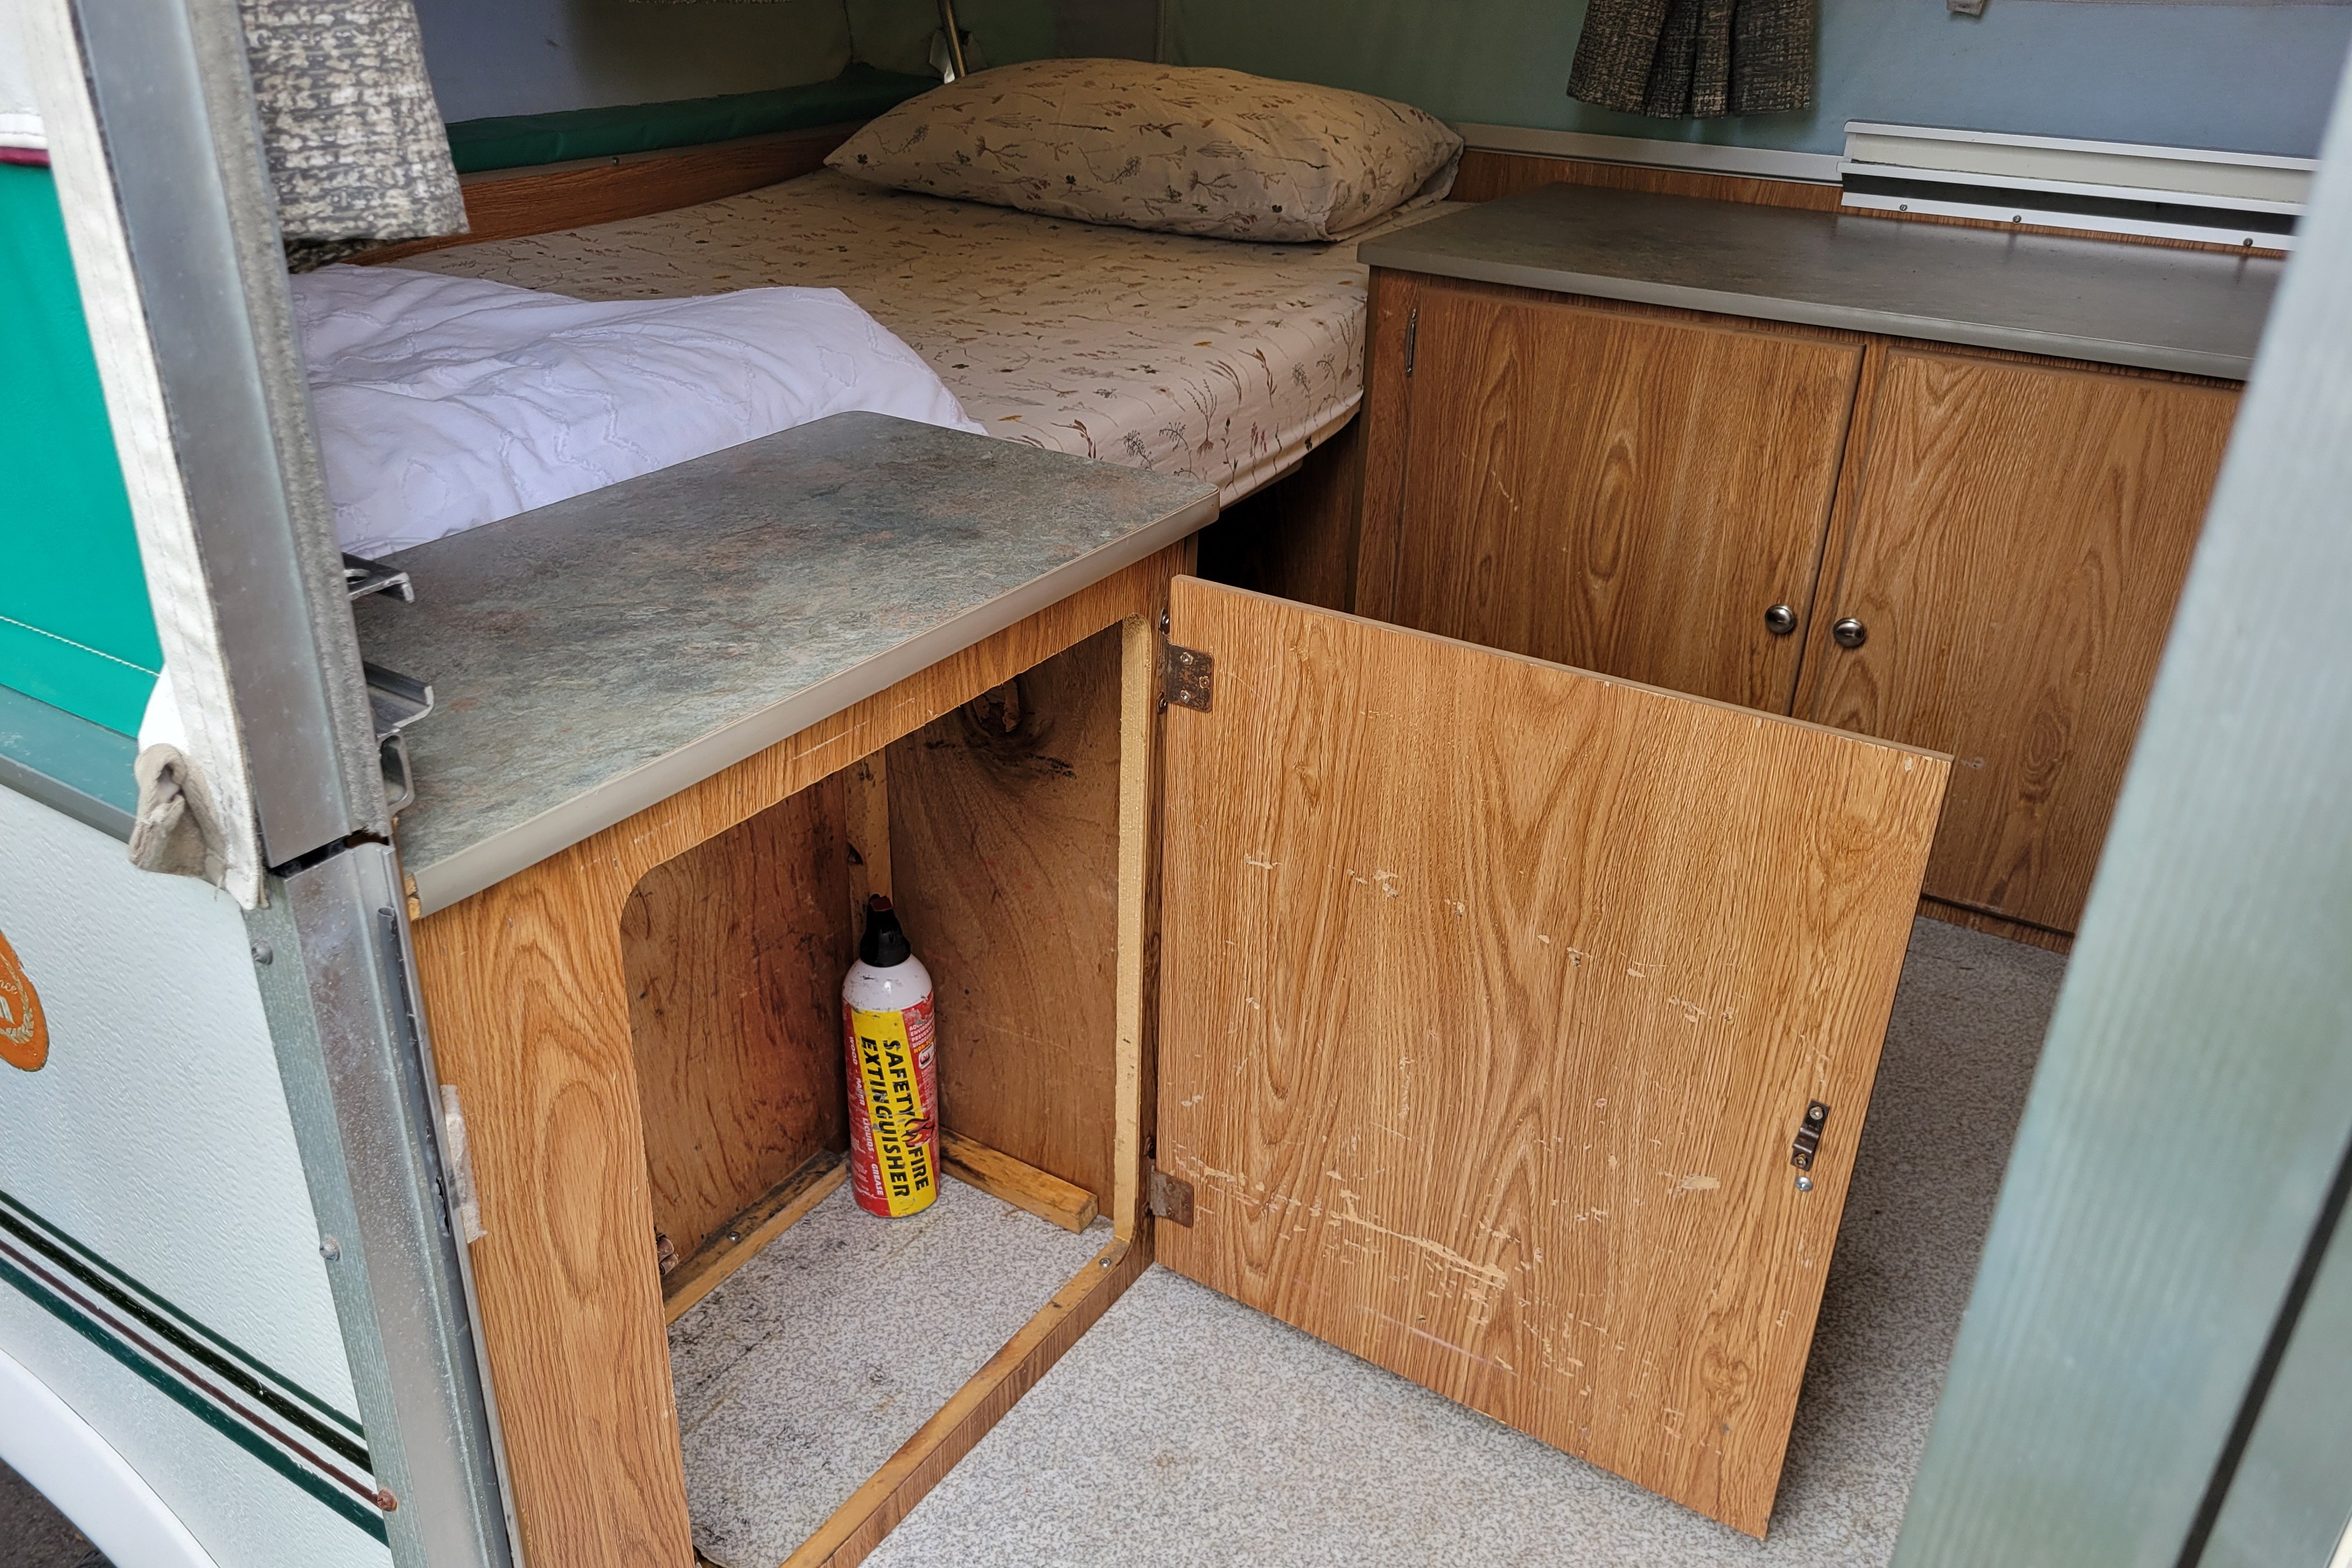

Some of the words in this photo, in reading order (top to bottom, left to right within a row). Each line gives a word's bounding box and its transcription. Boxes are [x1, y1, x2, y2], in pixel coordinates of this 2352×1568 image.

[849, 1037, 858, 1065] WOOD
[862, 1117, 874, 1152] LIQUIDS
[872, 1163, 884, 1196] GREASE
[861, 1036, 910, 1197] EXTINGUISHER
[883, 1040, 915, 1117] SAFETY
[908, 1146, 929, 1191] FIRE
